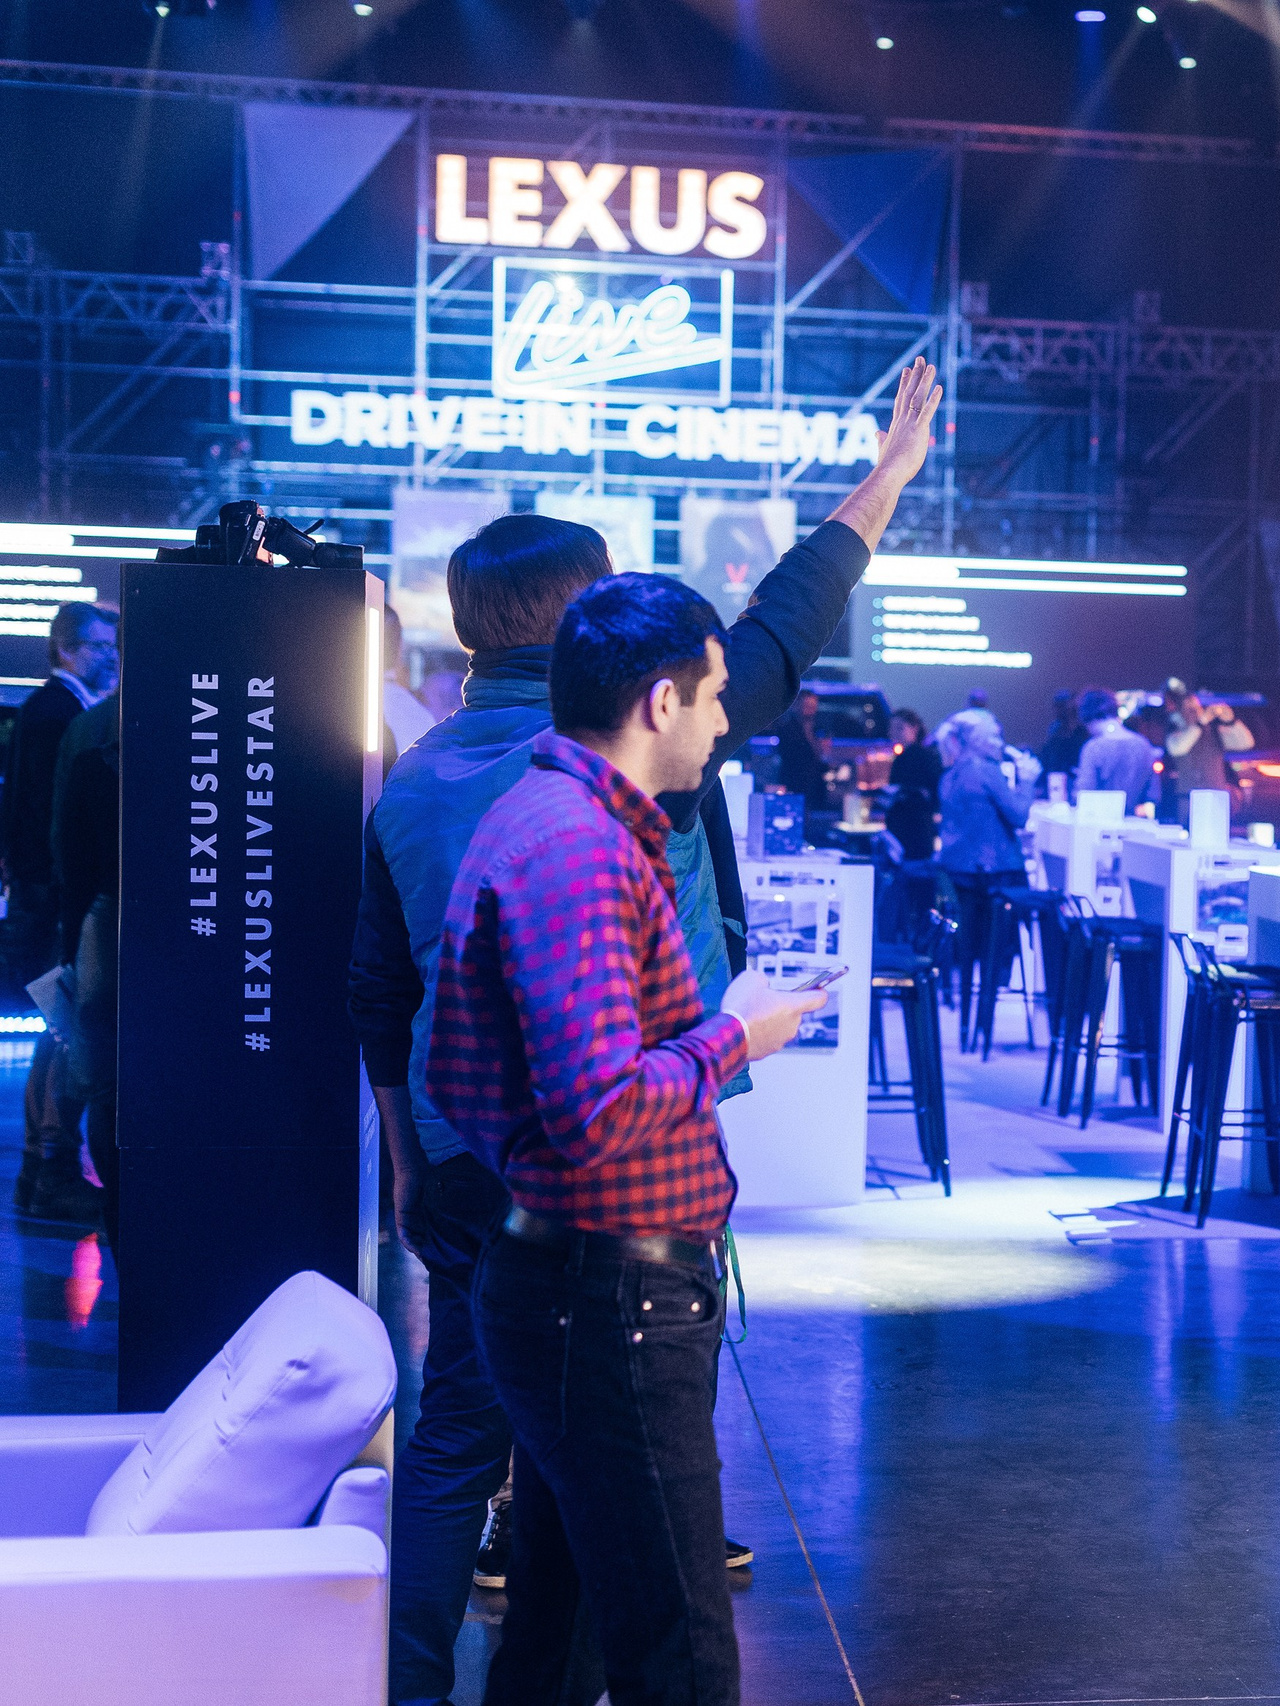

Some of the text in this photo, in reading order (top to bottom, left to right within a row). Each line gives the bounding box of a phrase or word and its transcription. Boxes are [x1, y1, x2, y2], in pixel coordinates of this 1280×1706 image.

[435, 153, 768, 260] LEXUS
[626, 405, 880, 466] CINEMA
[189, 672, 219, 937] #LEXUSLIVE
[244, 675, 275, 1052] #LEXUSLIVESTAR
